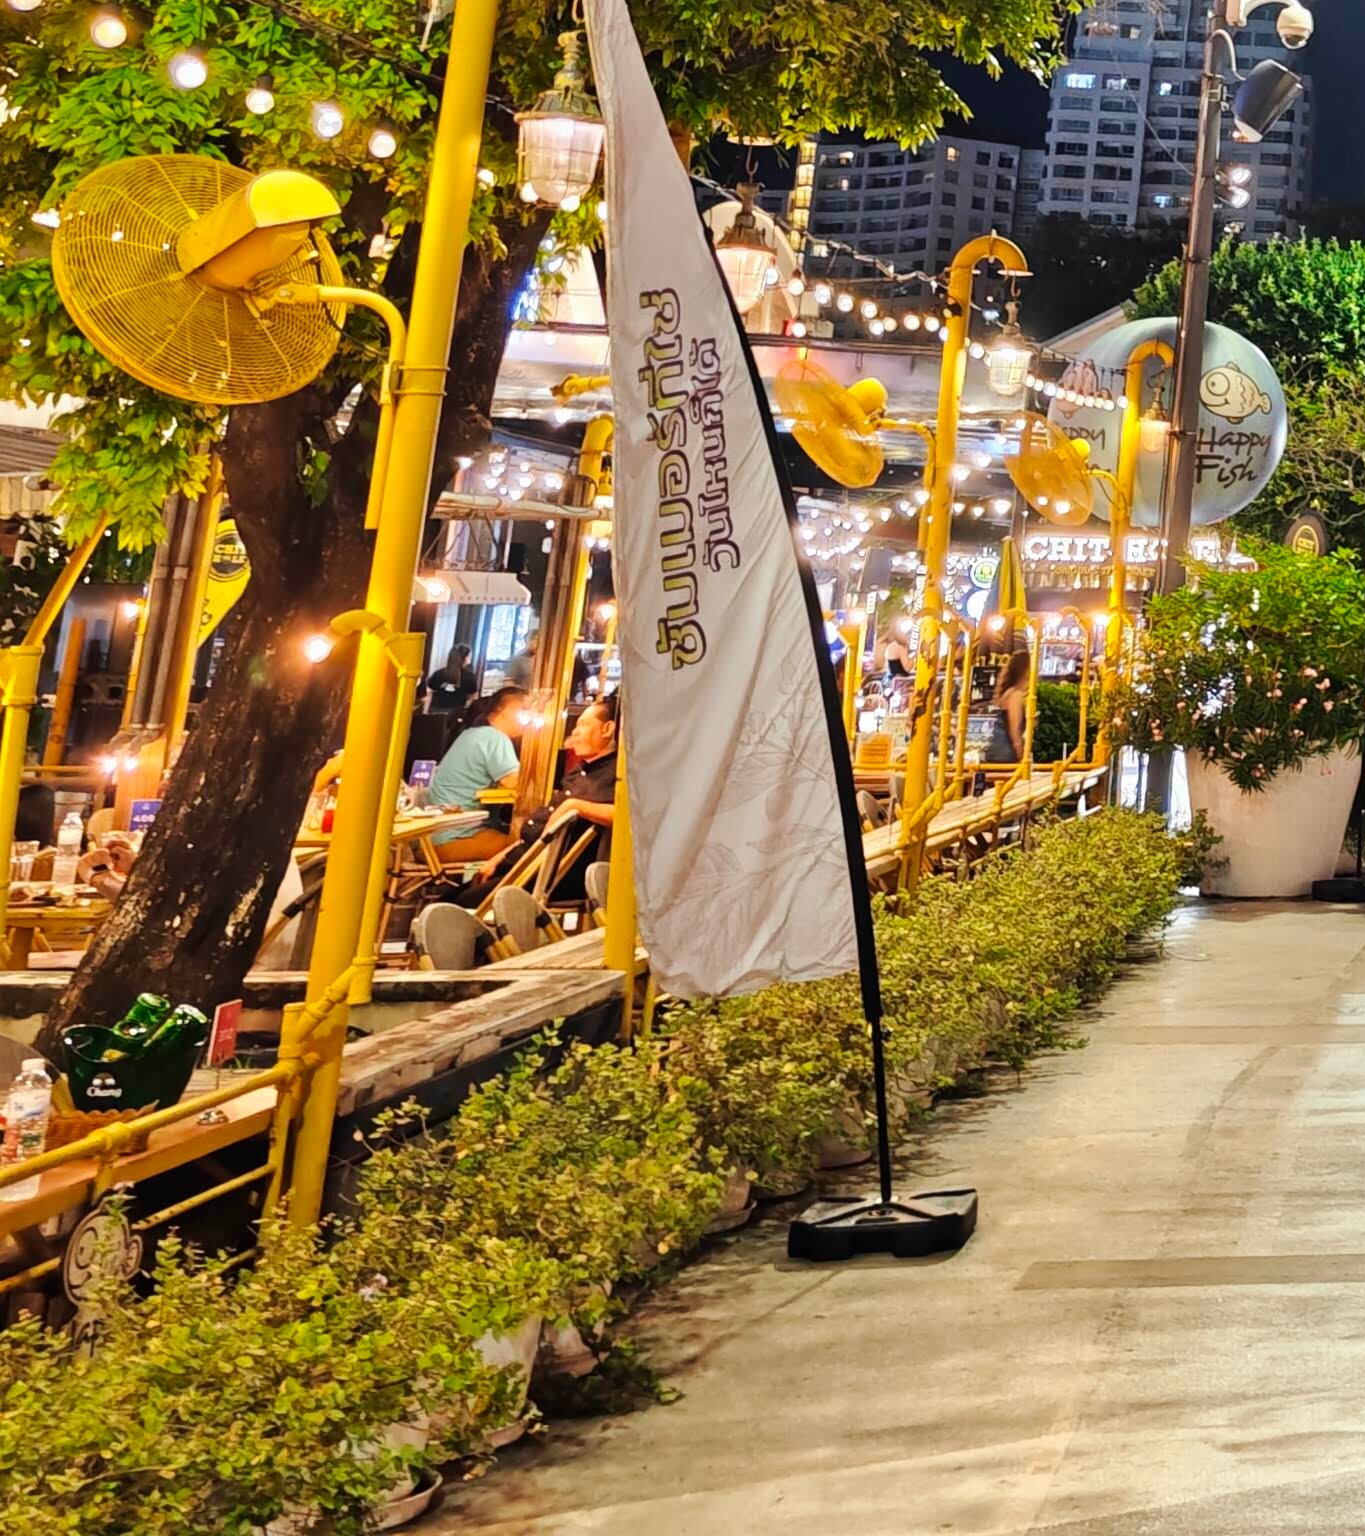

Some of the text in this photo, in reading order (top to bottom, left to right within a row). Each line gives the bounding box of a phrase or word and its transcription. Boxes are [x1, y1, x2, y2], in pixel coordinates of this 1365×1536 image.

[688, 337, 741, 574] วันไหนก็ได้
[1197, 426, 1272, 458] Happy
[1195, 455, 1258, 490] Fish
[1024, 535, 1110, 562] CHIT
[86, 1086, 123, 1099] Chang
